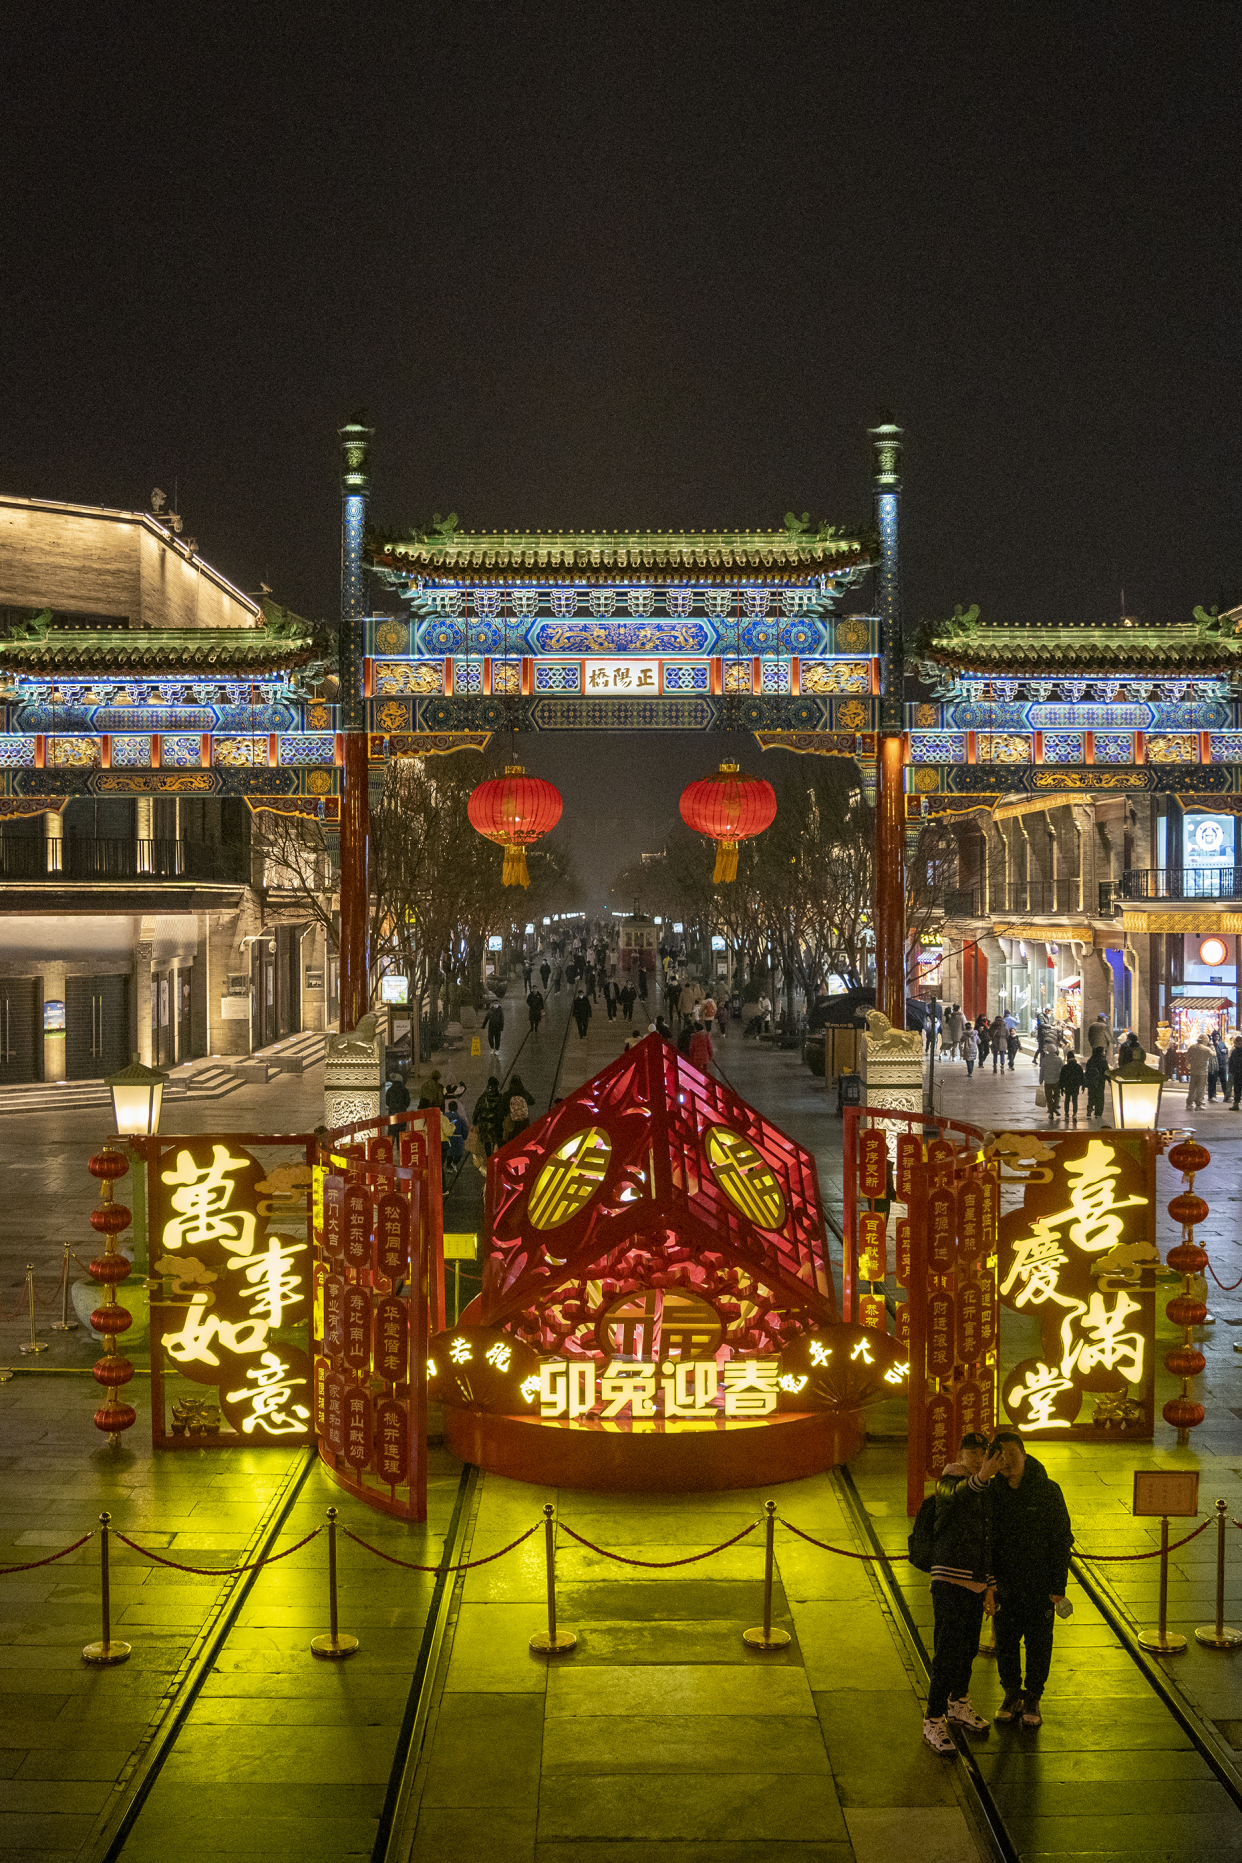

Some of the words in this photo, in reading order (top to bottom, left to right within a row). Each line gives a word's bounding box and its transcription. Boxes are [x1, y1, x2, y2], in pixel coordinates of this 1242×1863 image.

[529, 1128, 611, 1230] 福
[706, 1127, 785, 1229] 福
[866, 1140, 879, 1188] 岁序更新
[328, 1189, 339, 1247] 开门大吉
[350, 1197, 364, 1257] 福如东海
[385, 1206, 401, 1266] 松柏同春
[934, 1202, 949, 1261] 财源广进
[963, 1193, 977, 1252] 吉星高照
[161, 1144, 310, 1435] 萬事如意
[328, 1283, 340, 1345] 事业有成
[350, 1295, 364, 1357] 寿比南山
[384, 1306, 400, 1370] 华堂偕老
[963, 1290, 977, 1352] 花开富贵
[329, 1384, 341, 1443] 家庭和睦
[540, 1361, 780, 1418] 卯兔迎春
[962, 1393, 975, 1437] 好事连
[981, 1380, 991, 1436] 如日中天
[932, 1406, 948, 1469] 恭喜发财
